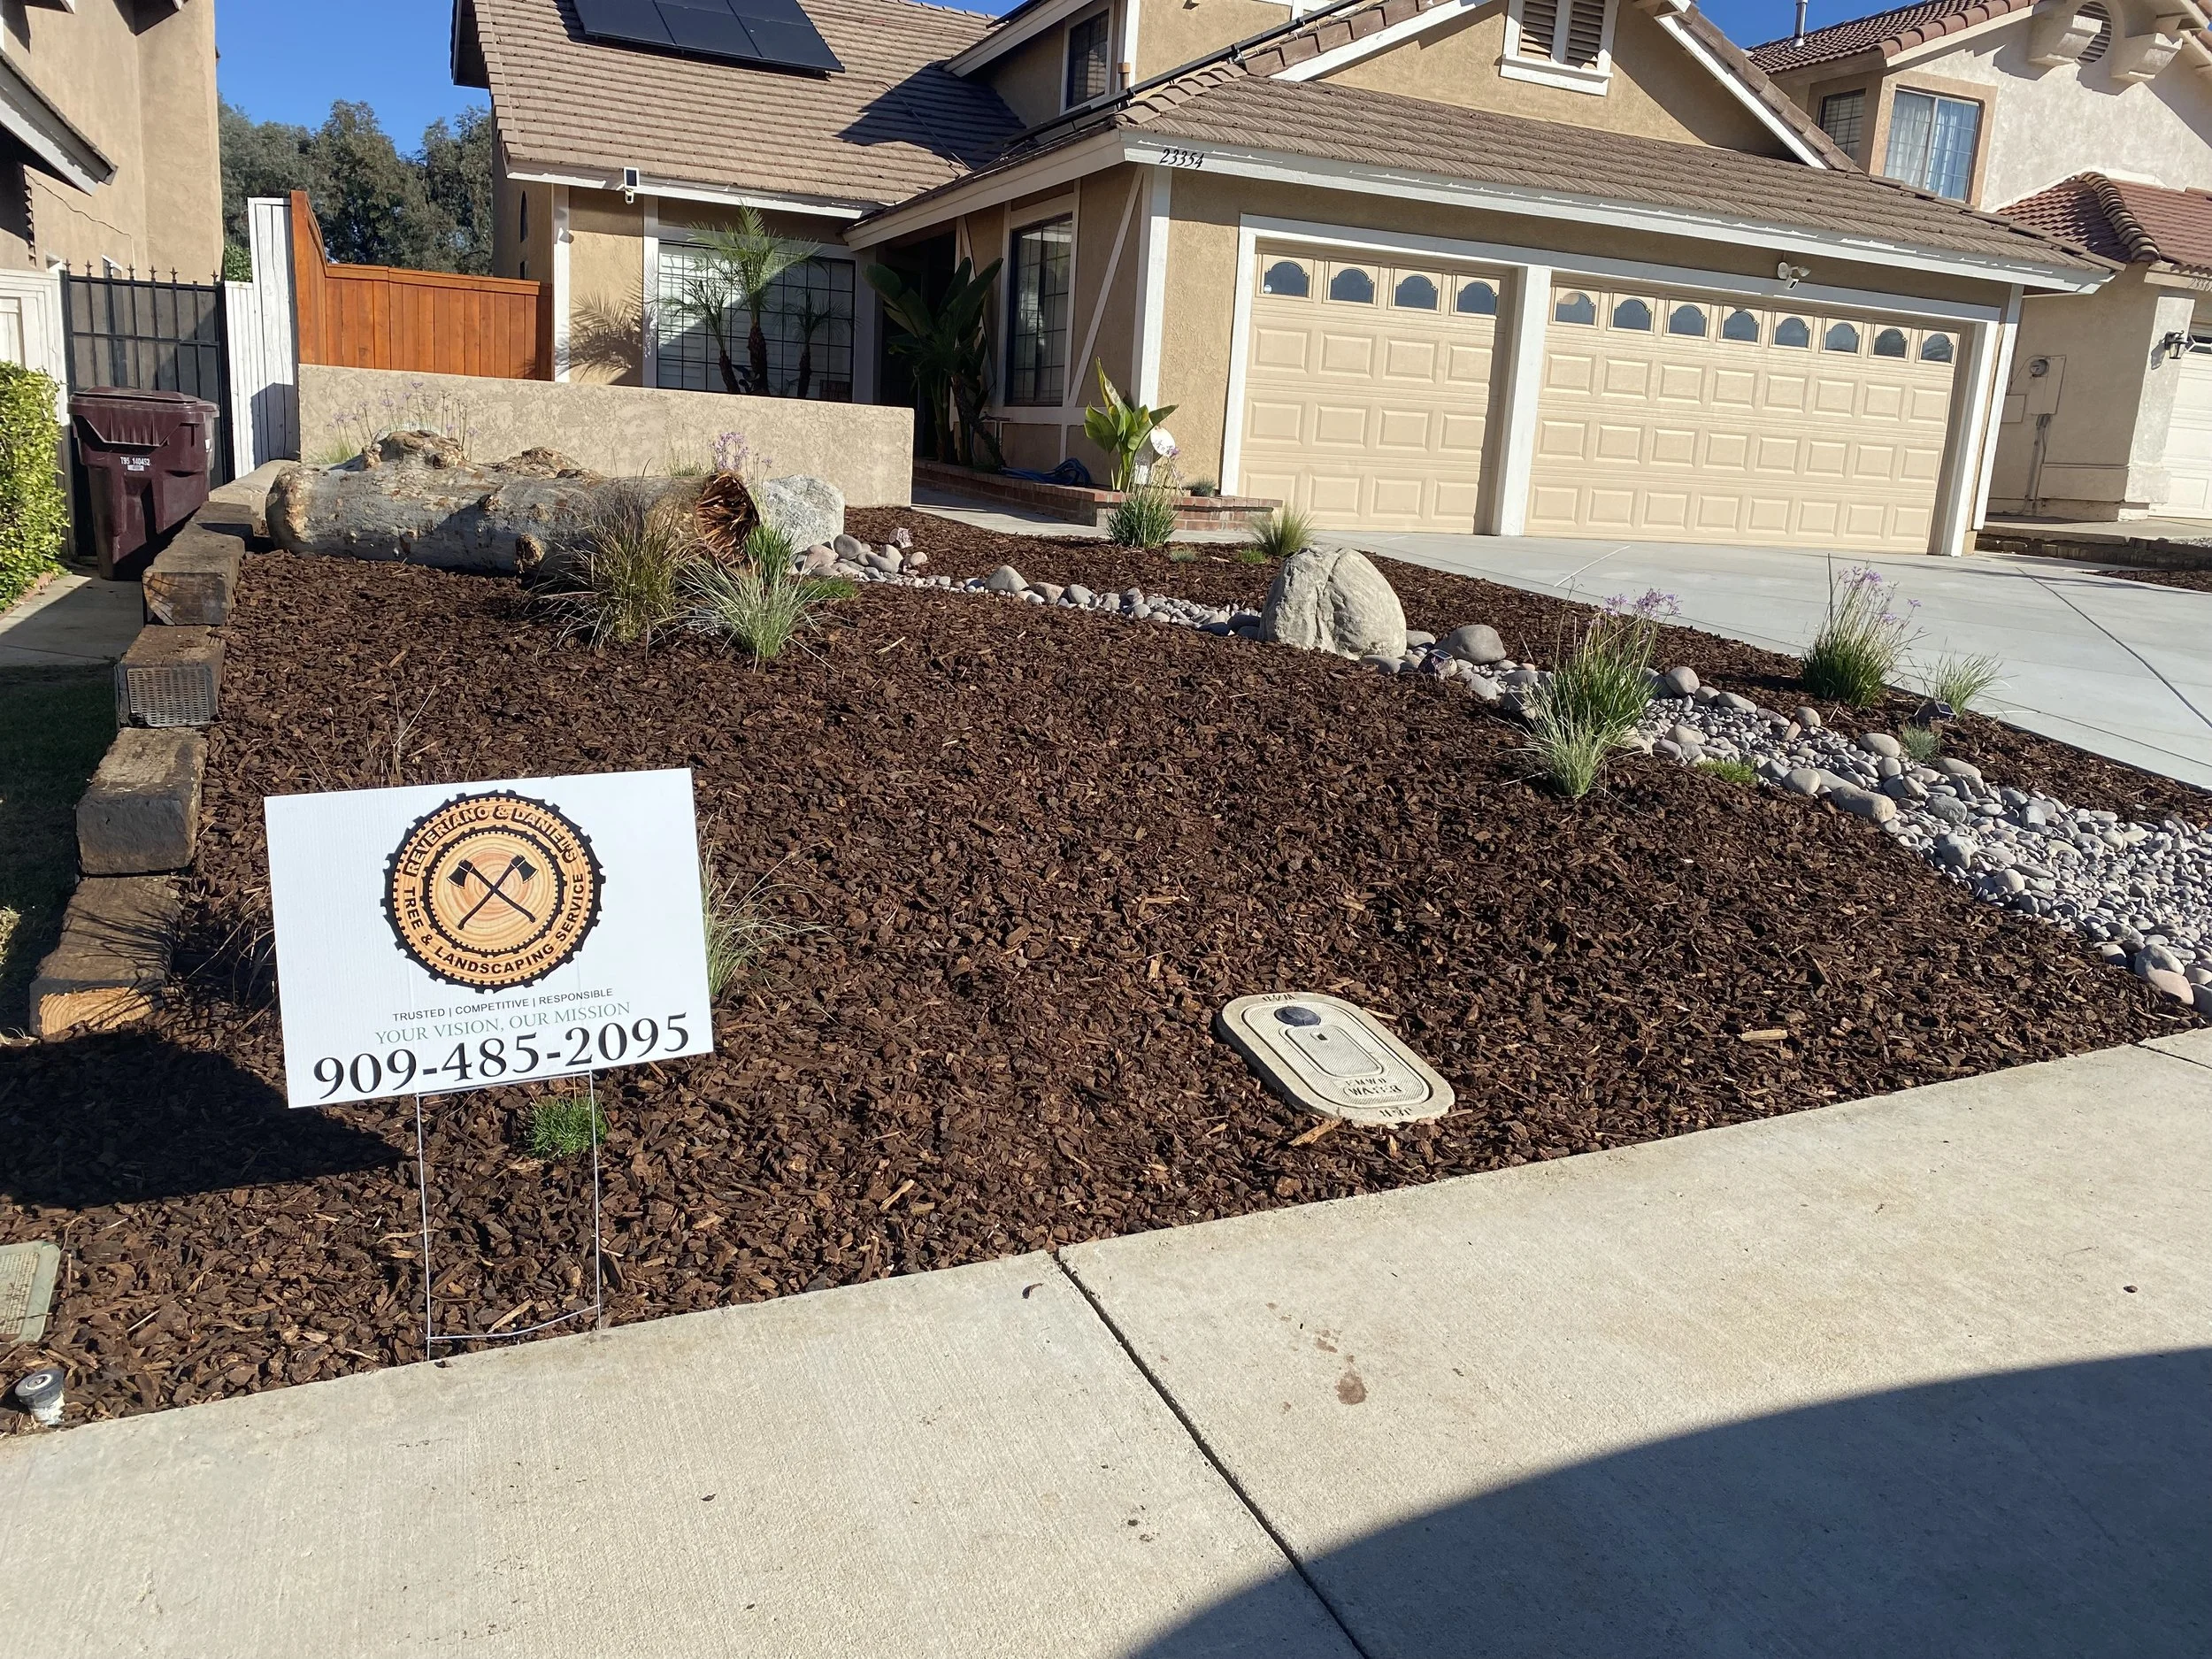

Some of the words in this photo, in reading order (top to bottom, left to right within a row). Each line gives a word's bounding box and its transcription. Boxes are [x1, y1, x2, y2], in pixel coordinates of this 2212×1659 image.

[1159, 149, 1204, 170] 23354
[2186, 277, 2212, 292] 2336
[403, 805, 489, 877] REVERIANO
[493, 805, 510, 819] &
[511, 807, 578, 864] DANIEL'S
[403, 887, 424, 930] TREE
[421, 933, 433, 946] &
[434, 943, 555, 974] LANDSCAPING
[556, 873, 585, 942] SERVICE
[375, 1026, 429, 1045] YOUR
[434, 1018, 504, 1038] VISION,
[509, 1012, 549, 1029] OUR
[555, 1002, 631, 1024] MISSION
[393, 1008, 445, 1022] TRUSTED
[455, 998, 530, 1015] COMPETITIVE
[539, 988, 613, 1005] RESPONSIBLE
[313, 1011, 689, 1100] 909-485-2095
[1348, 1085, 1402, 1096] WATER
